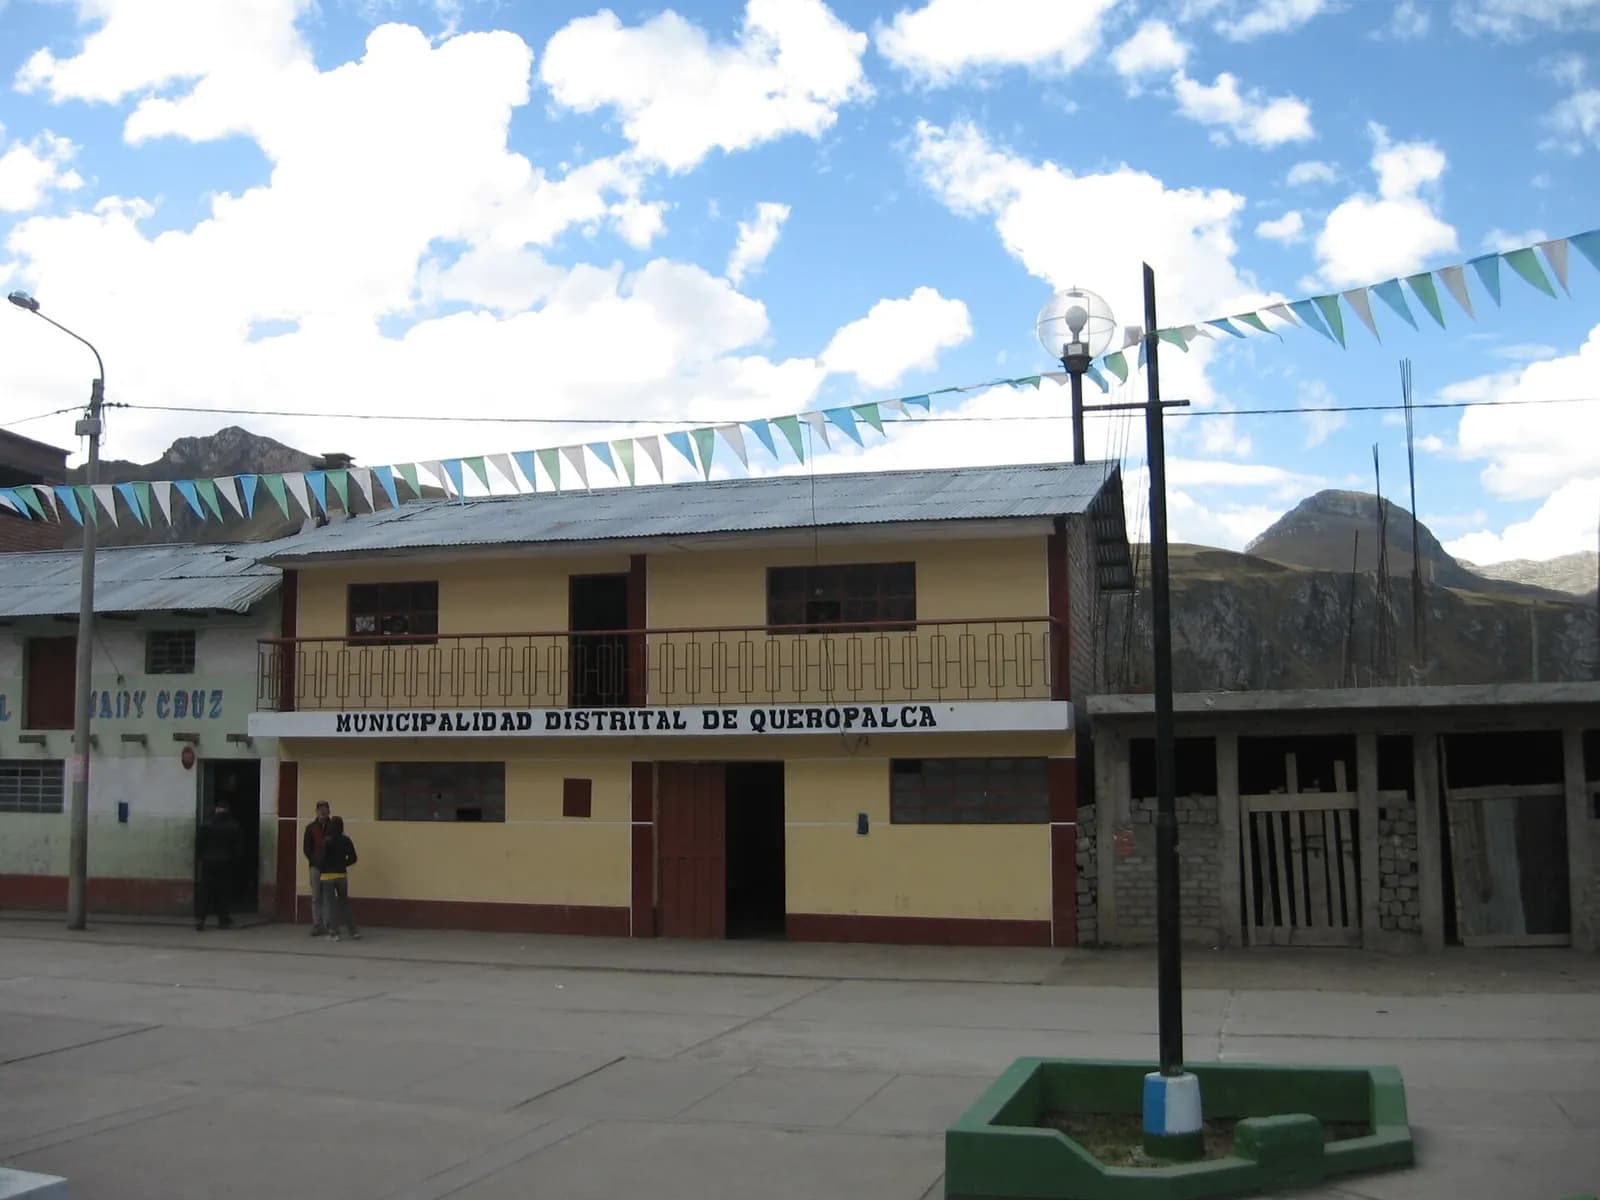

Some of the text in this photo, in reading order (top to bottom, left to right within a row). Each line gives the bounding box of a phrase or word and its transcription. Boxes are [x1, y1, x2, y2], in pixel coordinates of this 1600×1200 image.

[156, 689, 223, 719] CRUZ
[336, 705, 937, 733] MUNICIPALIDAD DISTRITAL DE QUEROPALCA
